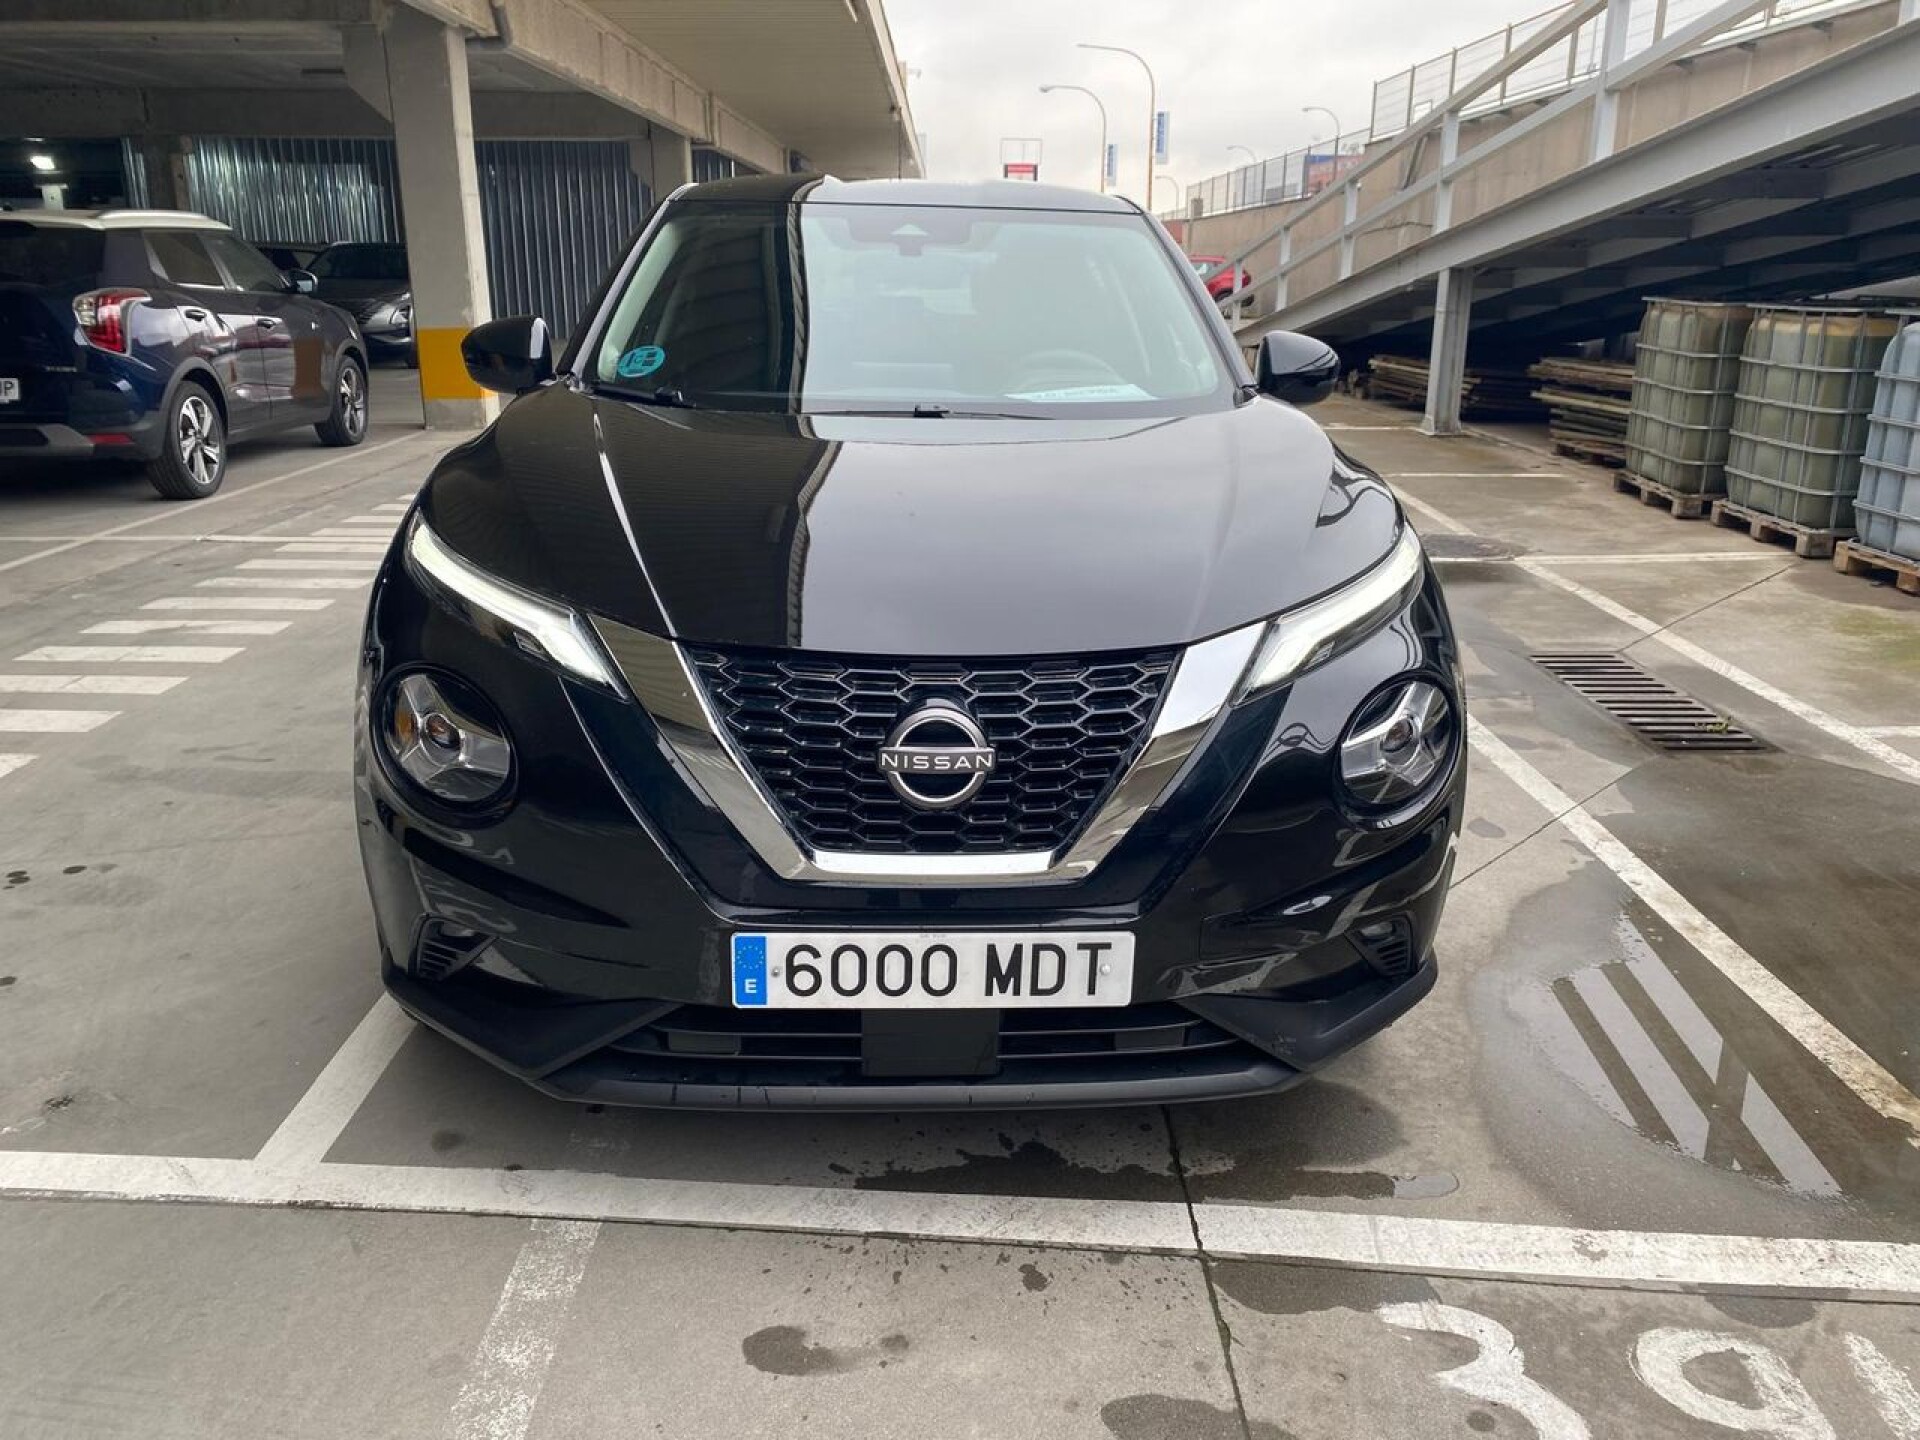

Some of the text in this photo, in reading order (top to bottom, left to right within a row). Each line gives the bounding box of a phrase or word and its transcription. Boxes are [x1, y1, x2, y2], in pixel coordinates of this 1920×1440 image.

[881, 752, 993, 770] NISSAN
[744, 942, 1113, 998] E 6000 MDT
